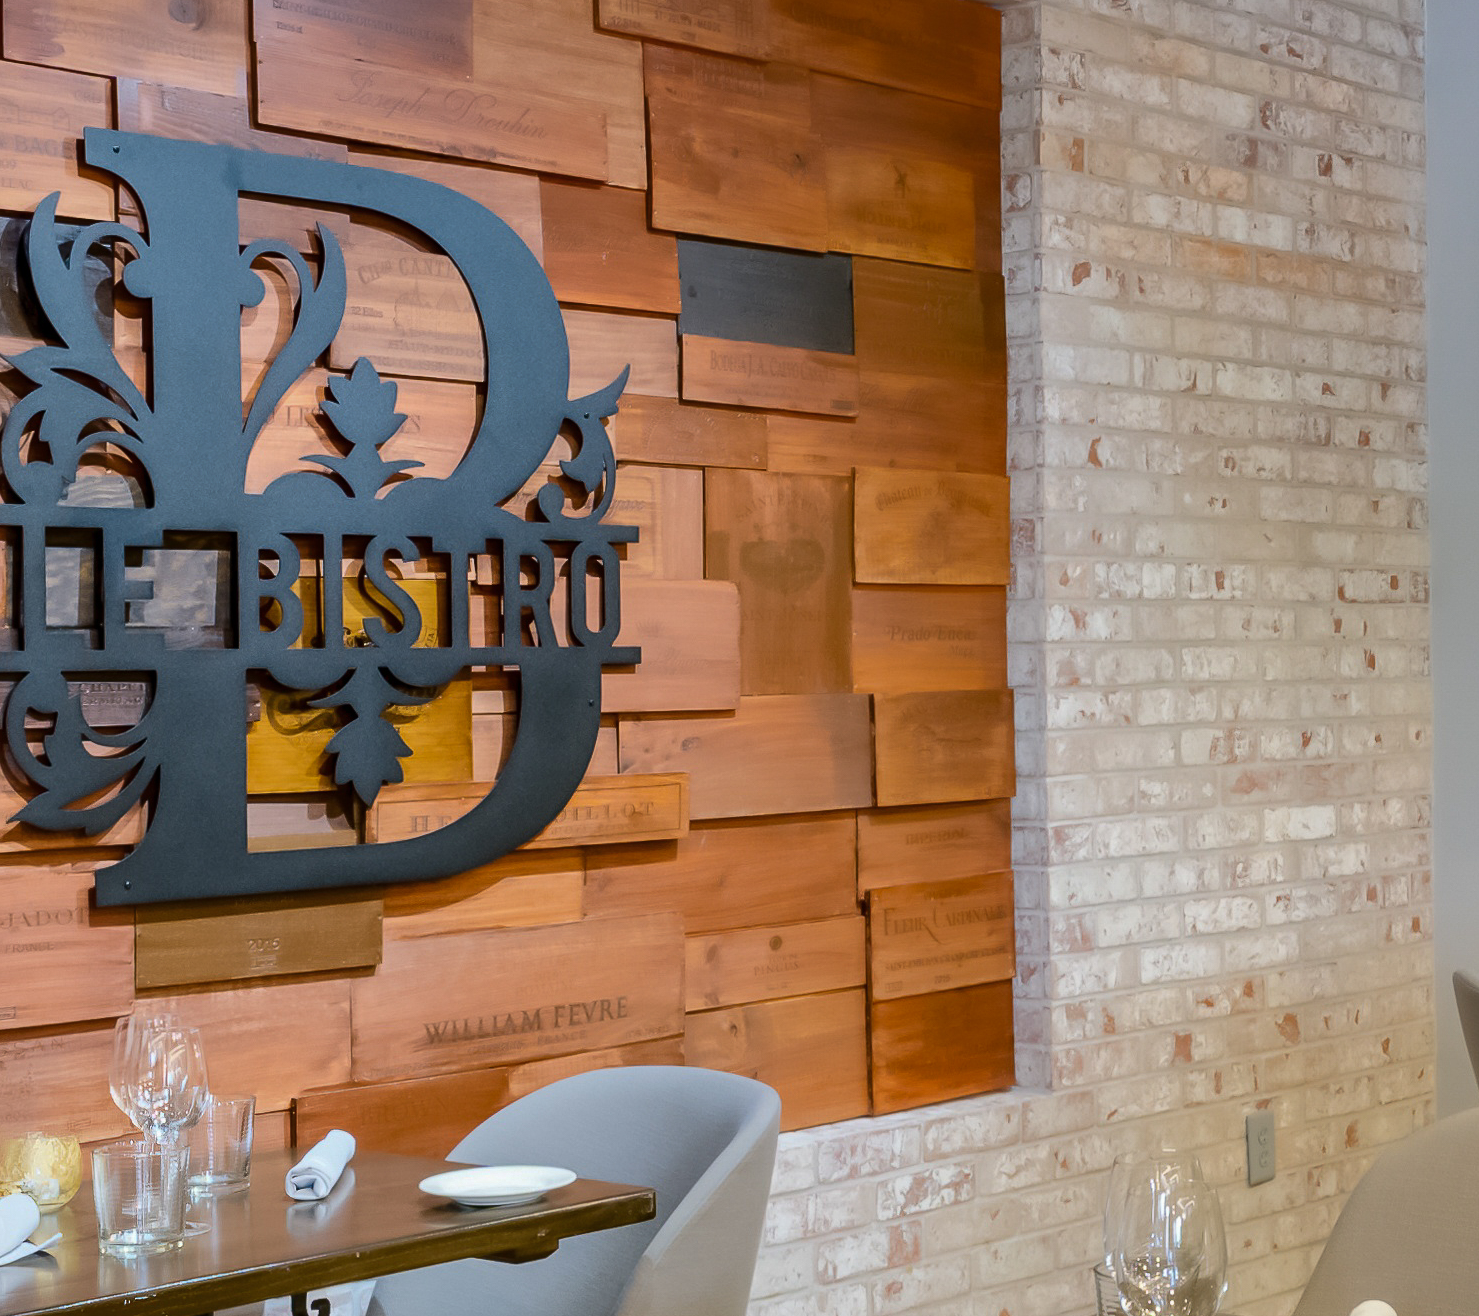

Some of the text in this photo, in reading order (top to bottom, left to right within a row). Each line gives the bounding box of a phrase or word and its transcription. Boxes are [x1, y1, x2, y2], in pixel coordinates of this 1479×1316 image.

[334, 69, 431, 119] Joseph
[14, 133, 77, 160] BAGE
[22, 526, 621, 652] LE BISTRO
[1, 907, 87, 930] JADOT
[5, 941, 55, 955] FRANCE
[423, 995, 629, 1045] WILLIAM FEVRE
